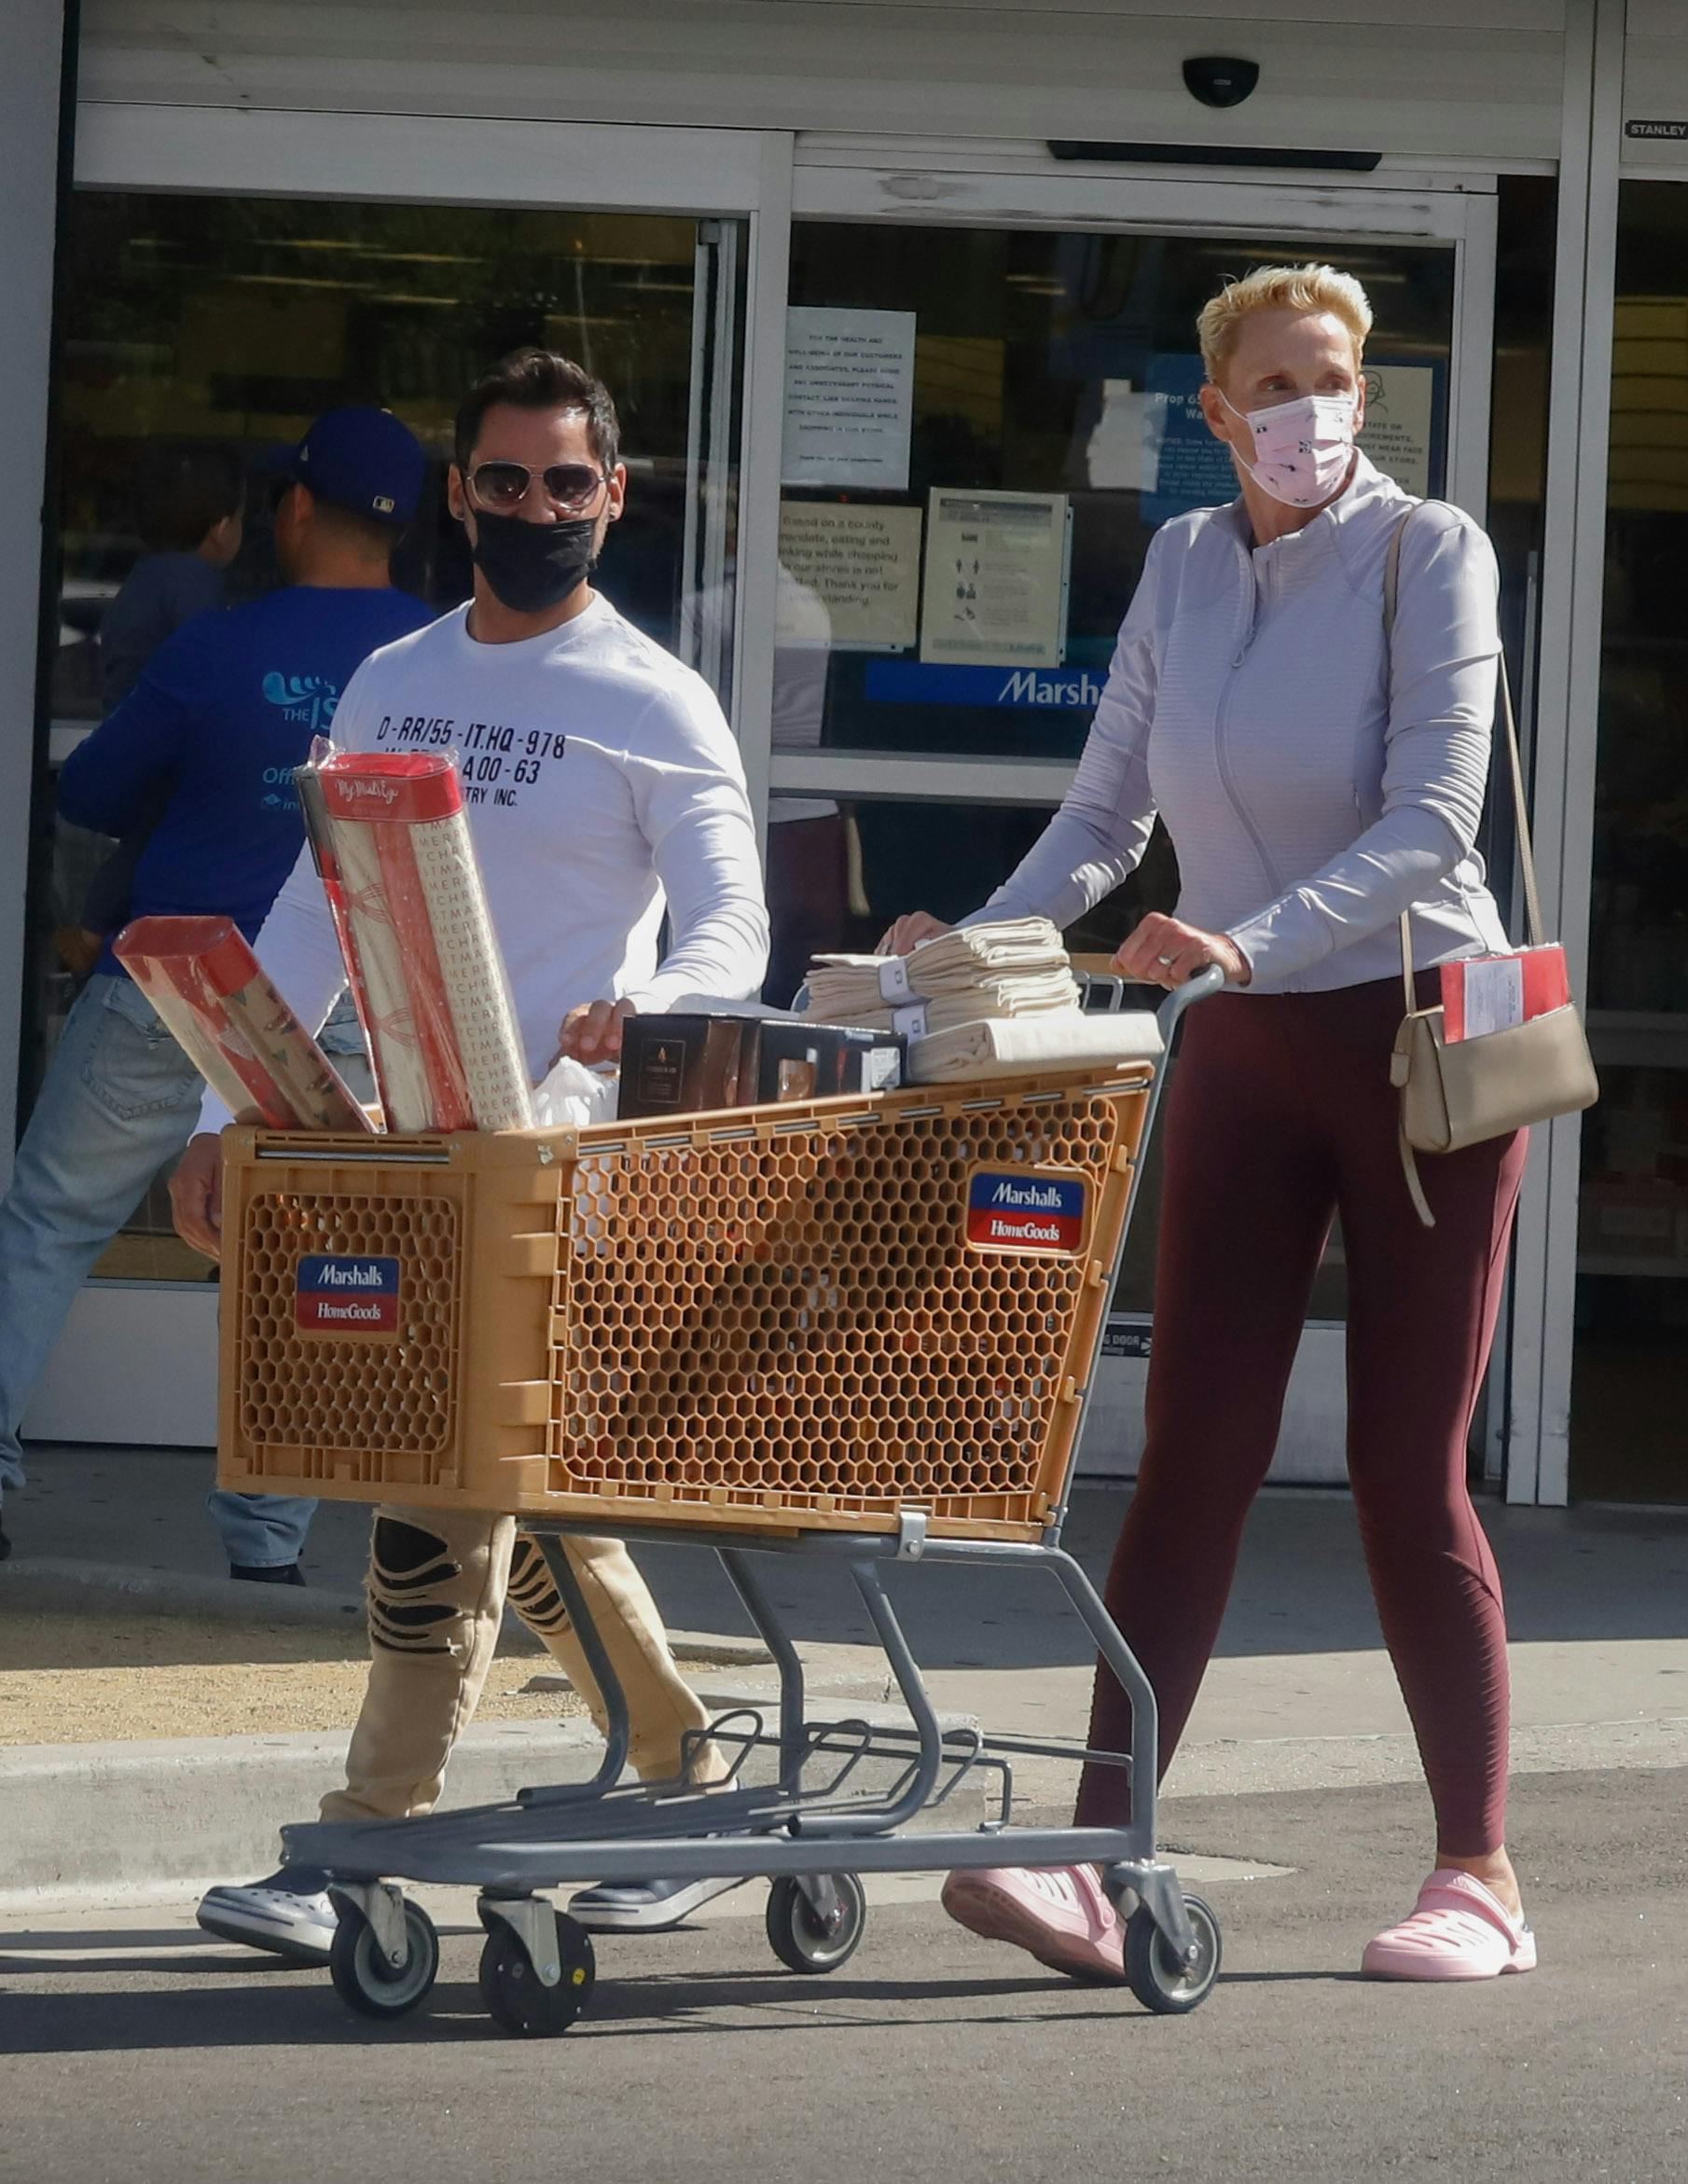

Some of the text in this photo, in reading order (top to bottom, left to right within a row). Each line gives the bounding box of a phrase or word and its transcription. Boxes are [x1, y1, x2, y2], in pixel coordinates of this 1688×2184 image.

[1631, 124, 1686, 135] STANLEY
[1155, 392, 1183, 405] Prop
[1185, 408, 1203, 420] Wa
[821, 518, 836, 528] on
[830, 534, 865, 547] eating
[815, 549, 843, 559] while
[847, 549, 898, 563] shopping
[794, 563, 811, 572] our
[824, 578, 856, 589] Thank
[859, 581, 881, 591] you
[883, 580, 899, 591] for
[997, 671, 1104, 705] Marsh
[283, 697, 338, 729] THE IS
[493, 789, 518, 808] INC.
[991, 1182, 1062, 1208] Marshalls
[990, 1219, 1060, 1241] HomeGoods
[317, 1264, 383, 1286] Marshalls
[317, 1302, 381, 1320] HomeGoods
[1112, 1334, 1140, 1346] DOOR
